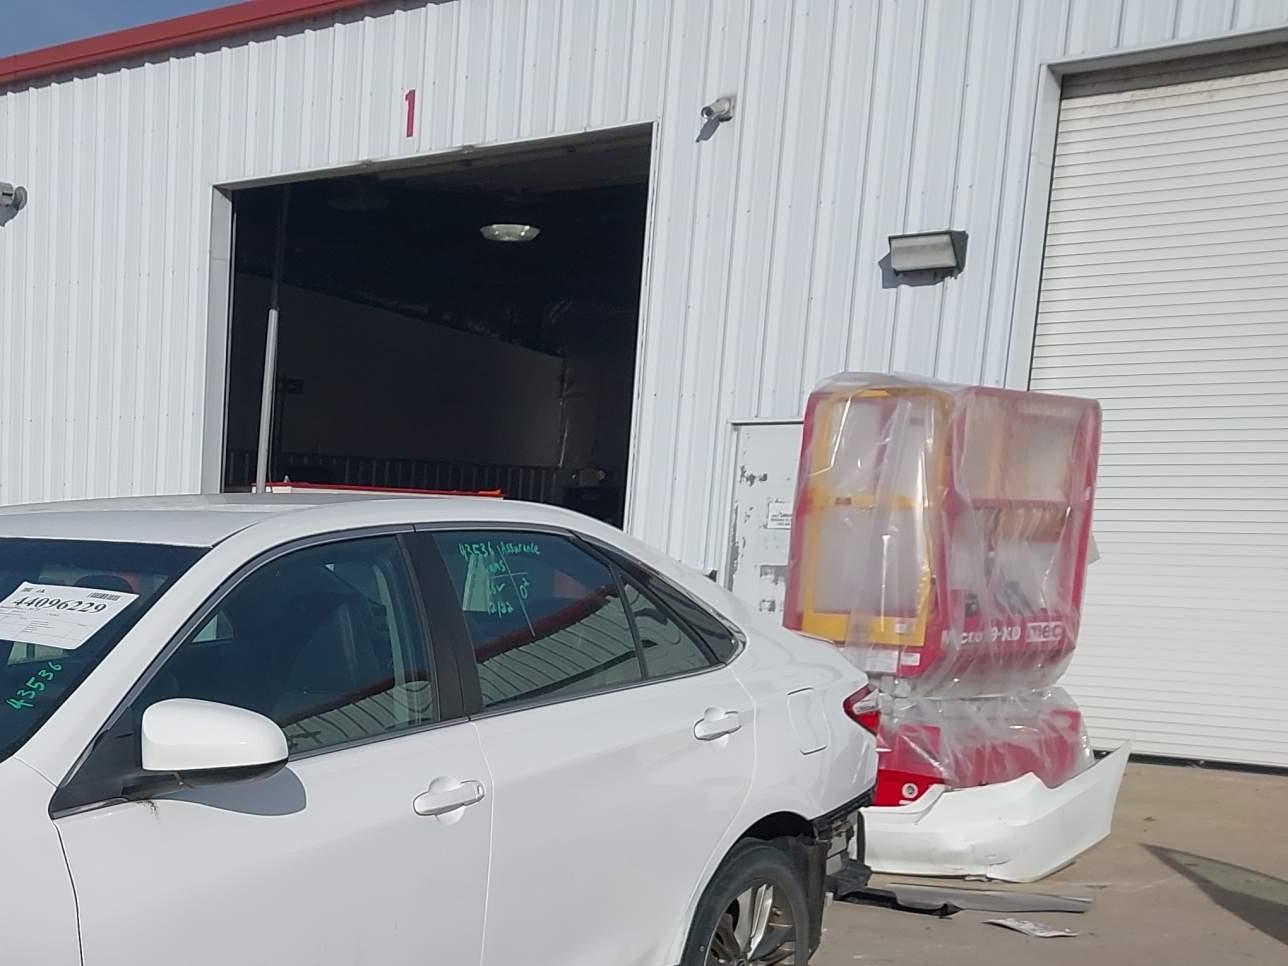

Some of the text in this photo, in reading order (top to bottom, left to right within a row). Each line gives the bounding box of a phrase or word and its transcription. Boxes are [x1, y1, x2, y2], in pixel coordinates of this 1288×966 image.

[405, 89, 416, 138] 1
[13, 595, 108, 614] 44096229
[7, 661, 62, 709] 43536
